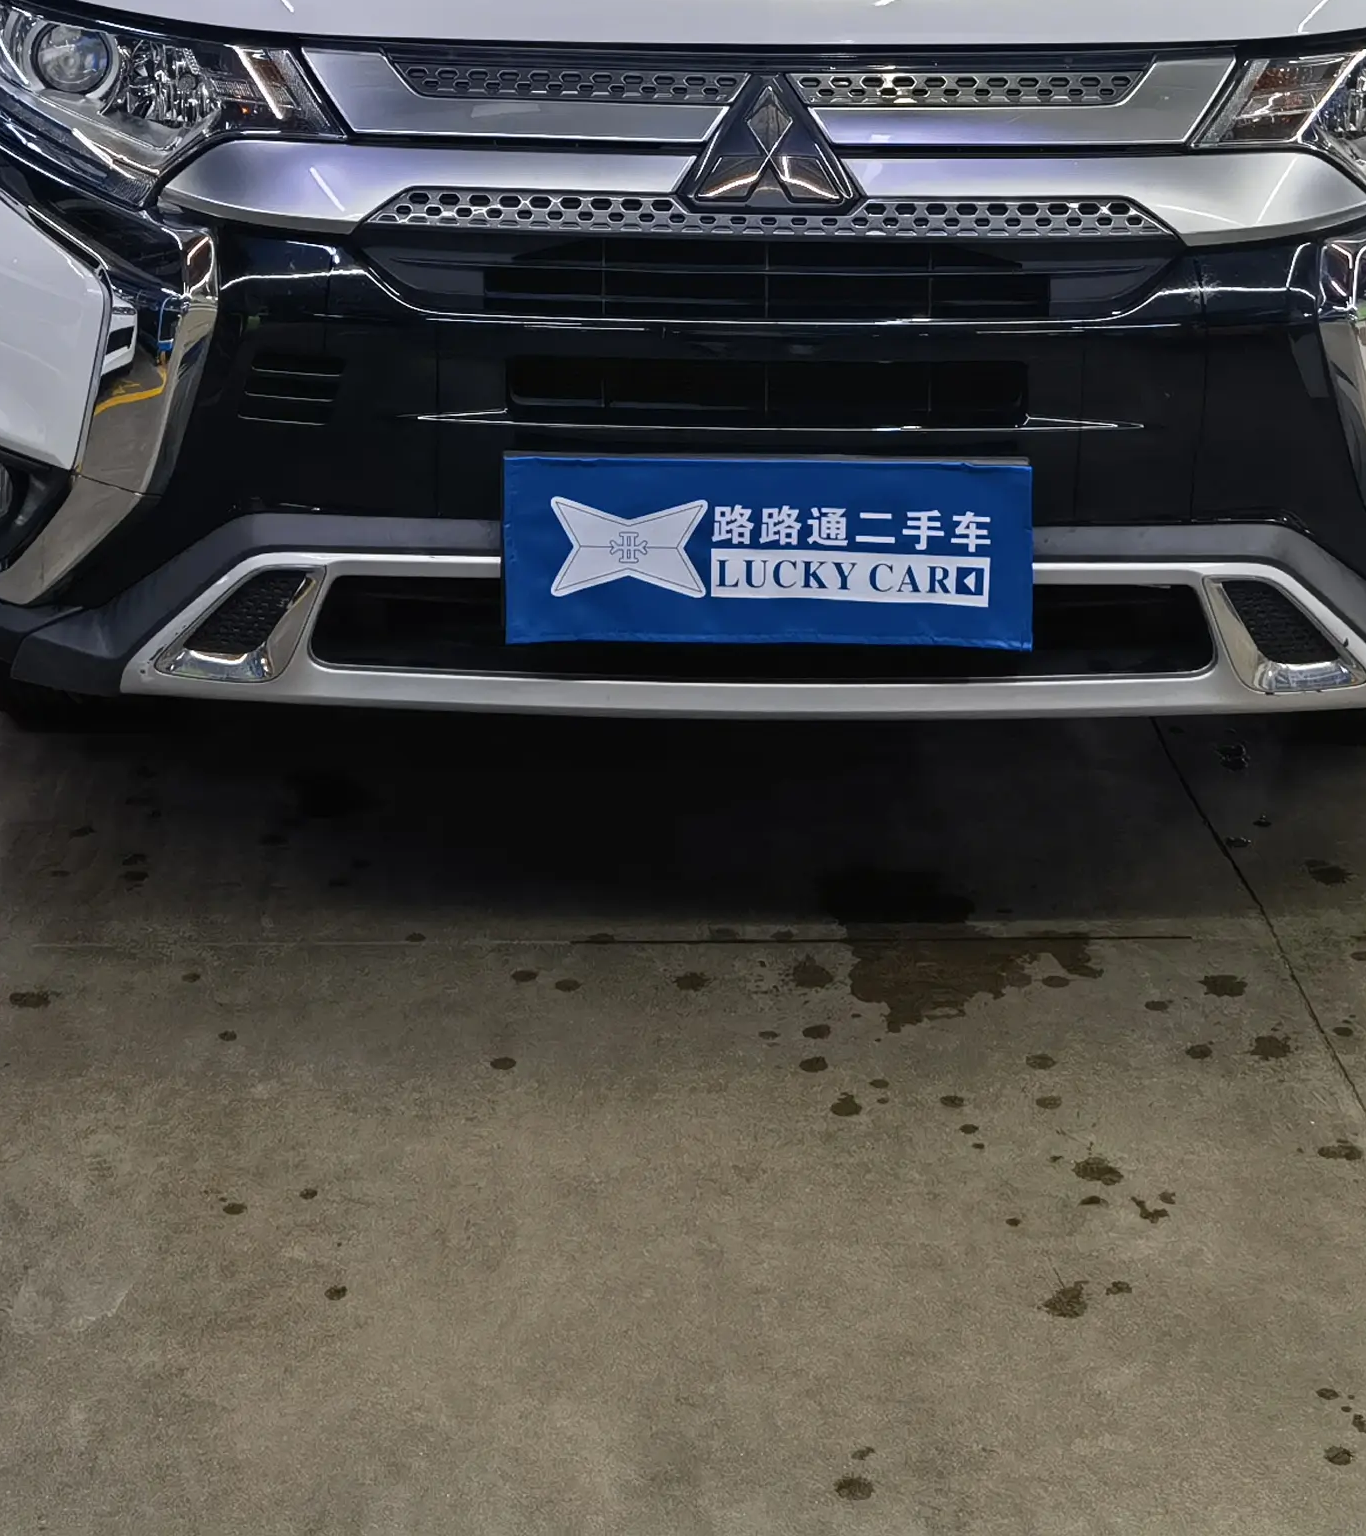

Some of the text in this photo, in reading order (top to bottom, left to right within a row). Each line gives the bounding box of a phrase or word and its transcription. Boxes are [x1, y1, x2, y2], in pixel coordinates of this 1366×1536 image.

[711, 504, 991, 552] 路路通二手车
[716, 558, 953, 594] LUCKY CAR
